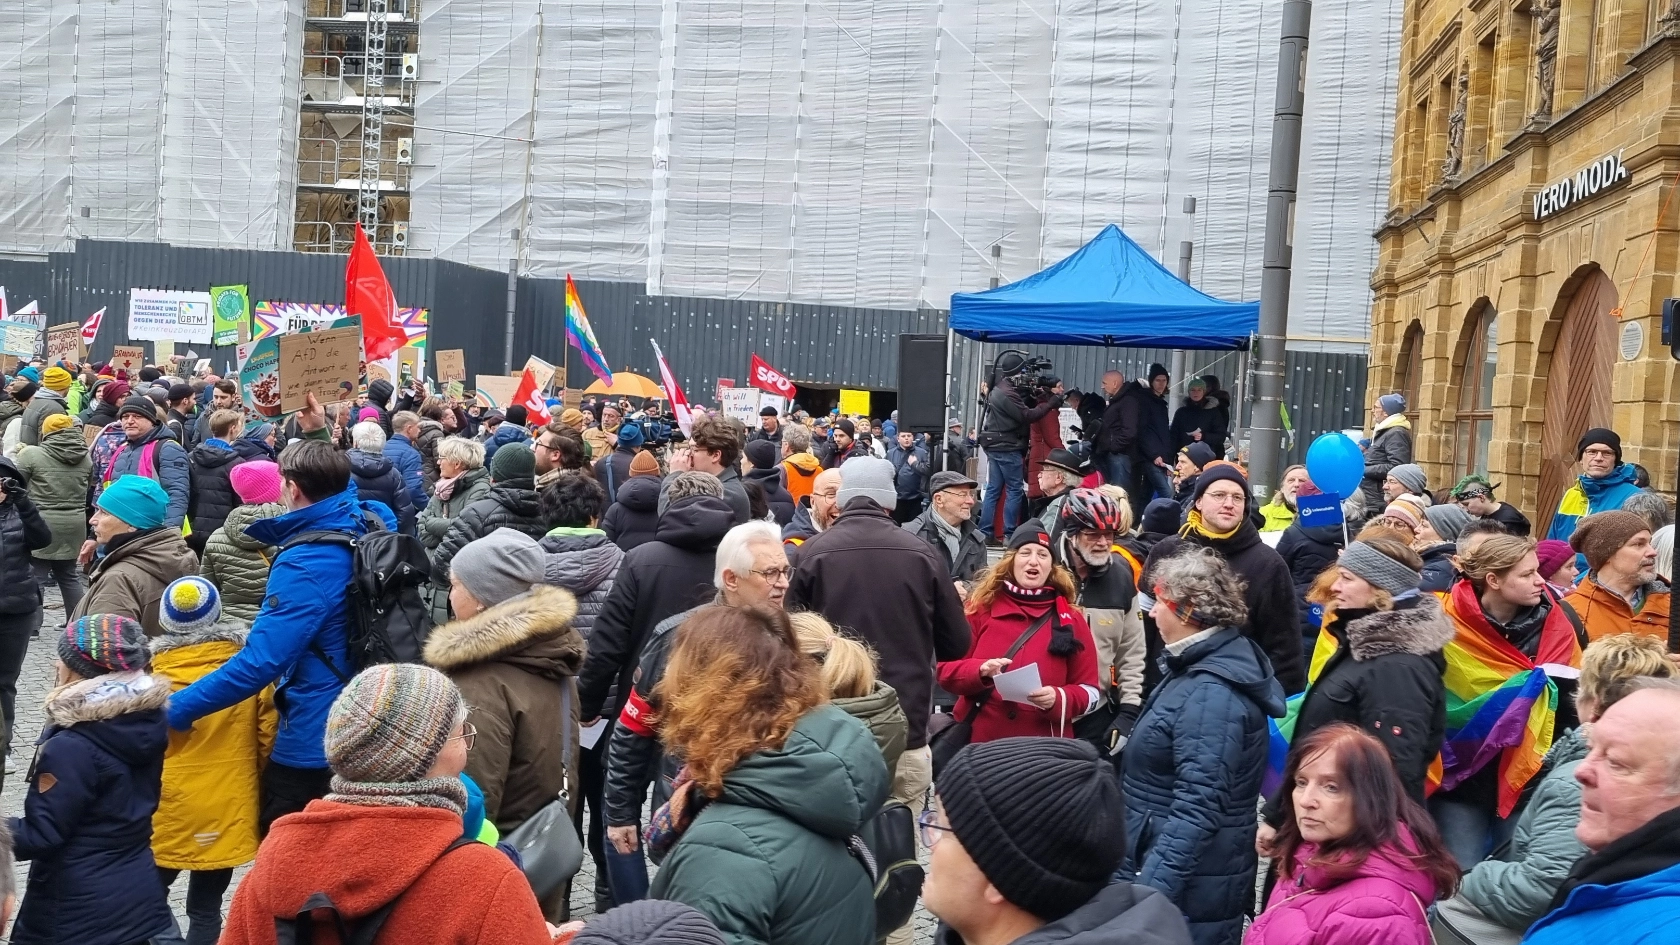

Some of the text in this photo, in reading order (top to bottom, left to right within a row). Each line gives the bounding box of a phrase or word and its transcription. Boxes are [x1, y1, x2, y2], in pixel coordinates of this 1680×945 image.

[1533, 148, 1626, 220] VERO MODA
[307, 334, 336, 344] Wenn
[291, 347, 339, 363] AfD die
[243, 362, 264, 374] CHOCO
[757, 366, 791, 391] SPD
